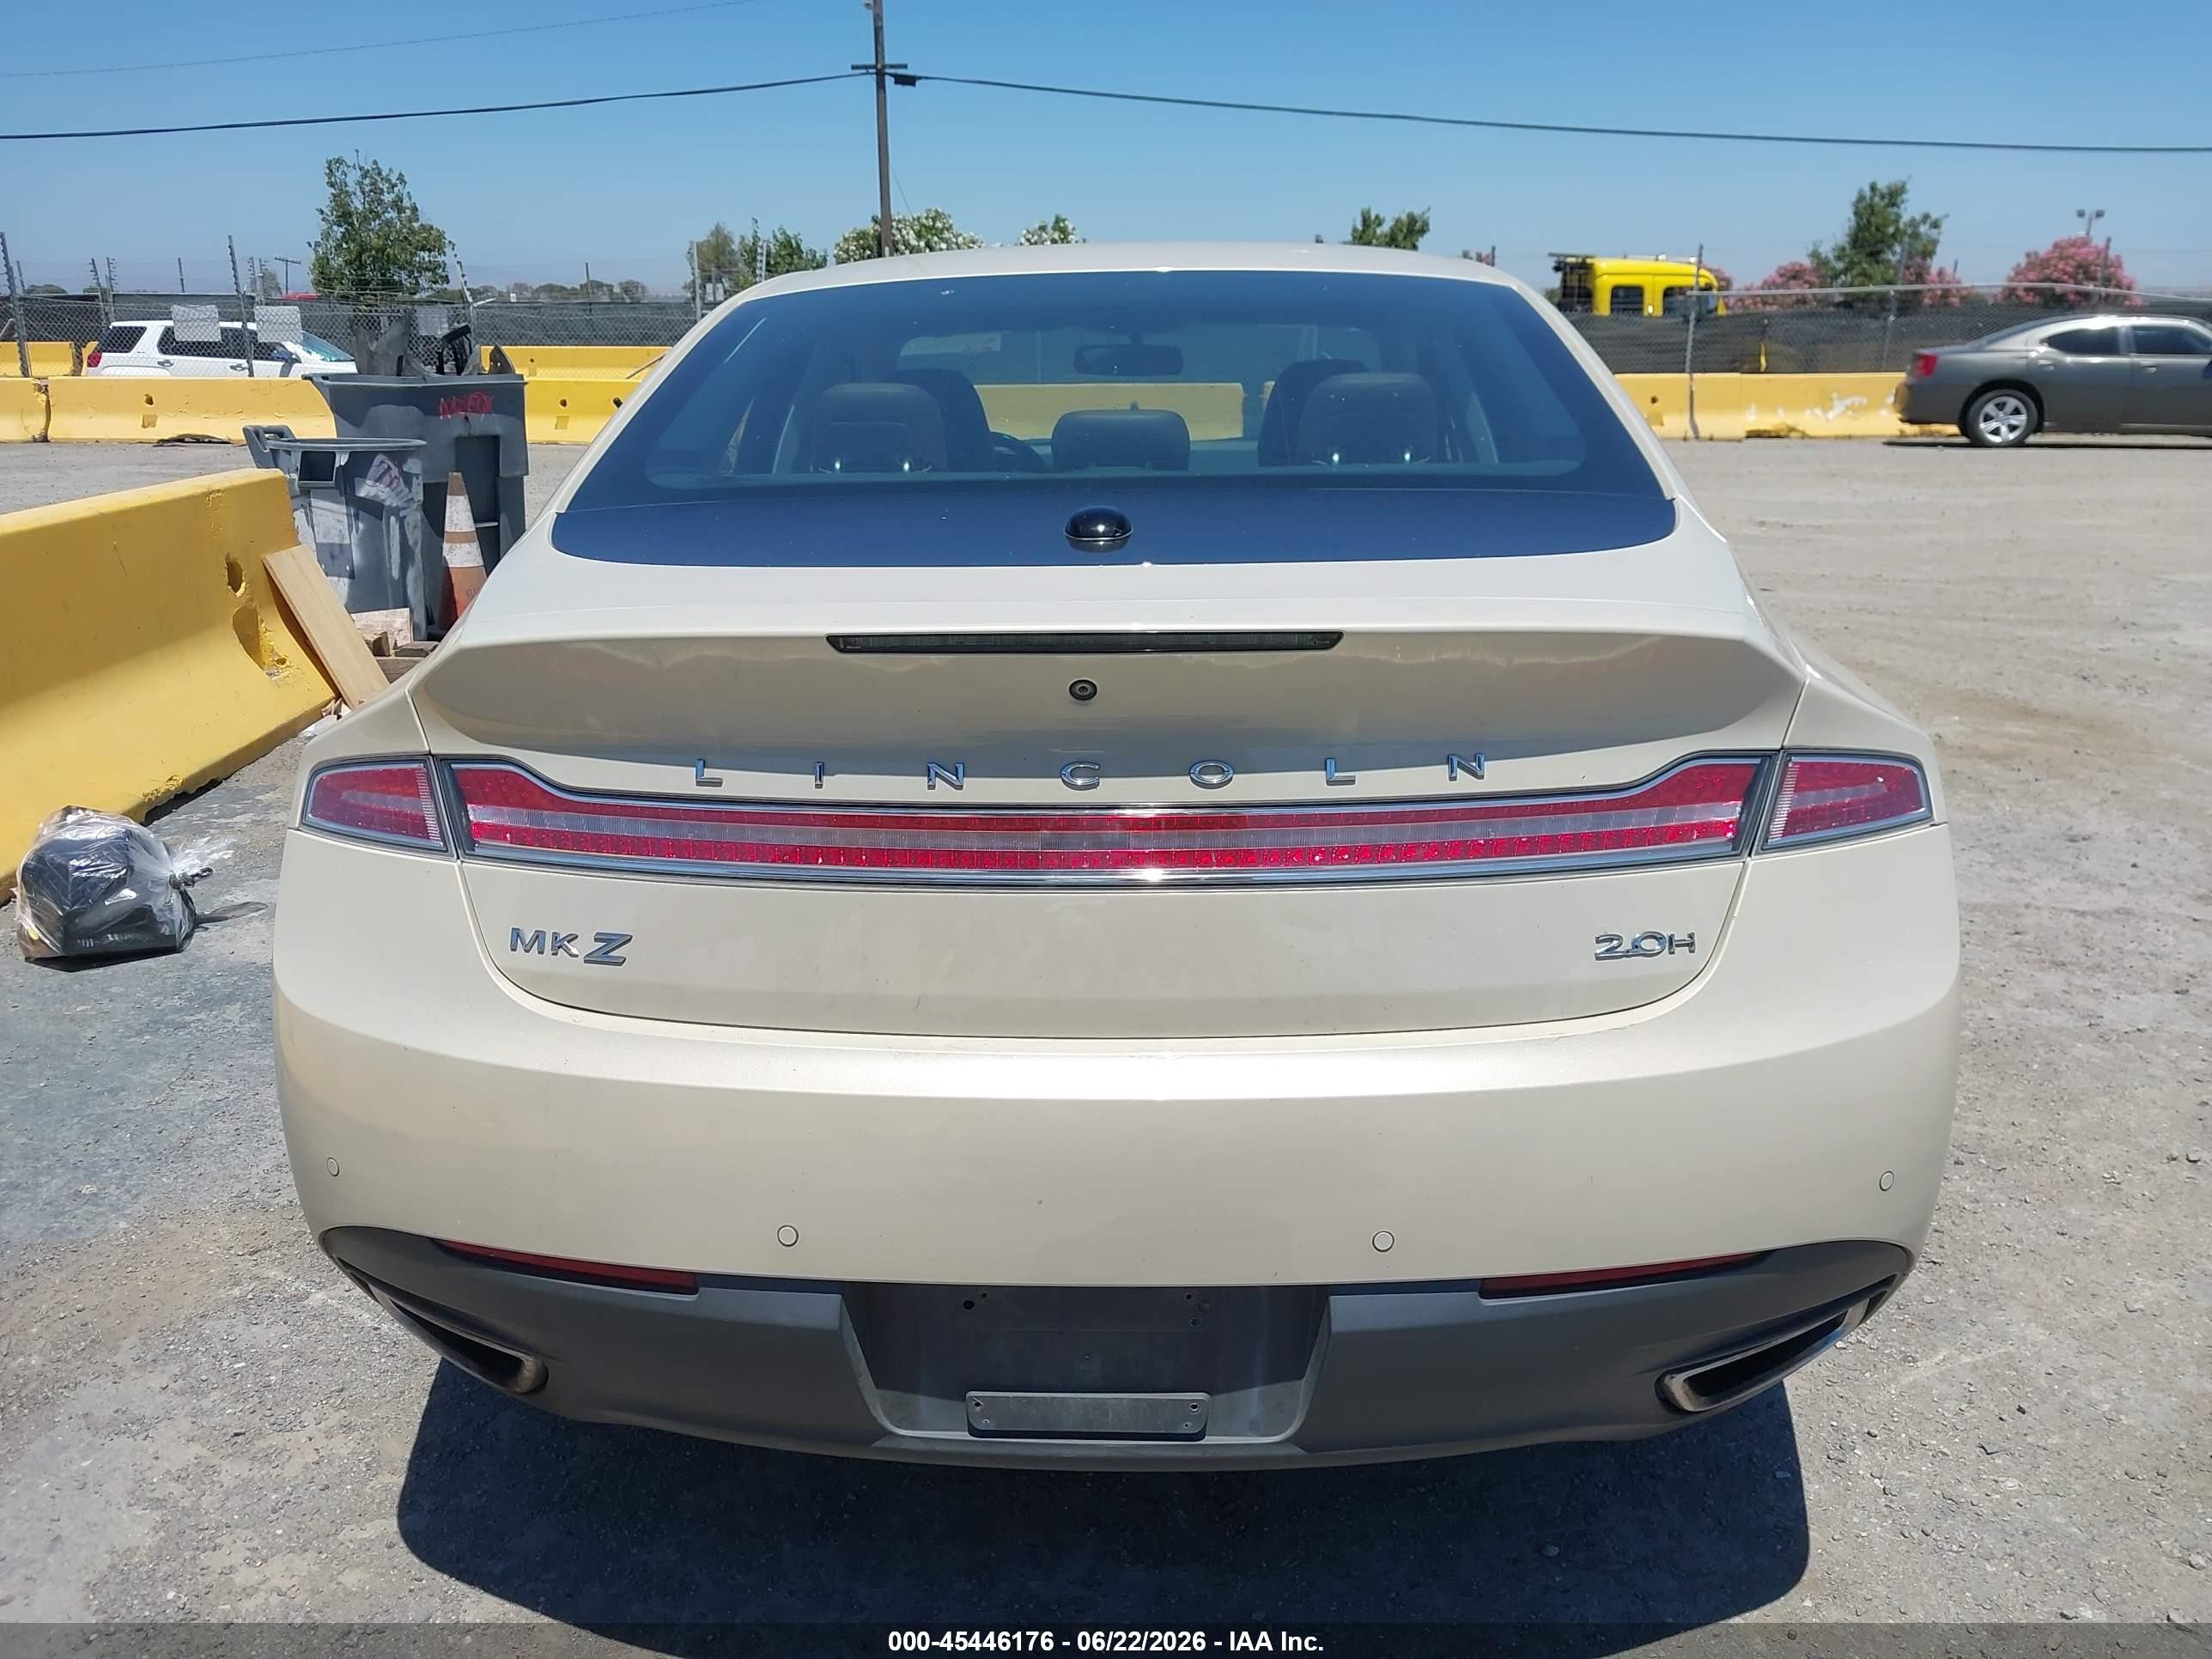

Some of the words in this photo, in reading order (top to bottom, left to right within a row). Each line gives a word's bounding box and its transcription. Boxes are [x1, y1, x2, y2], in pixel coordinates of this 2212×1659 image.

[695, 753, 1486, 791] LINCOLN
[509, 927, 634, 967] MKZ
[1595, 931, 1696, 961] 2.0H
